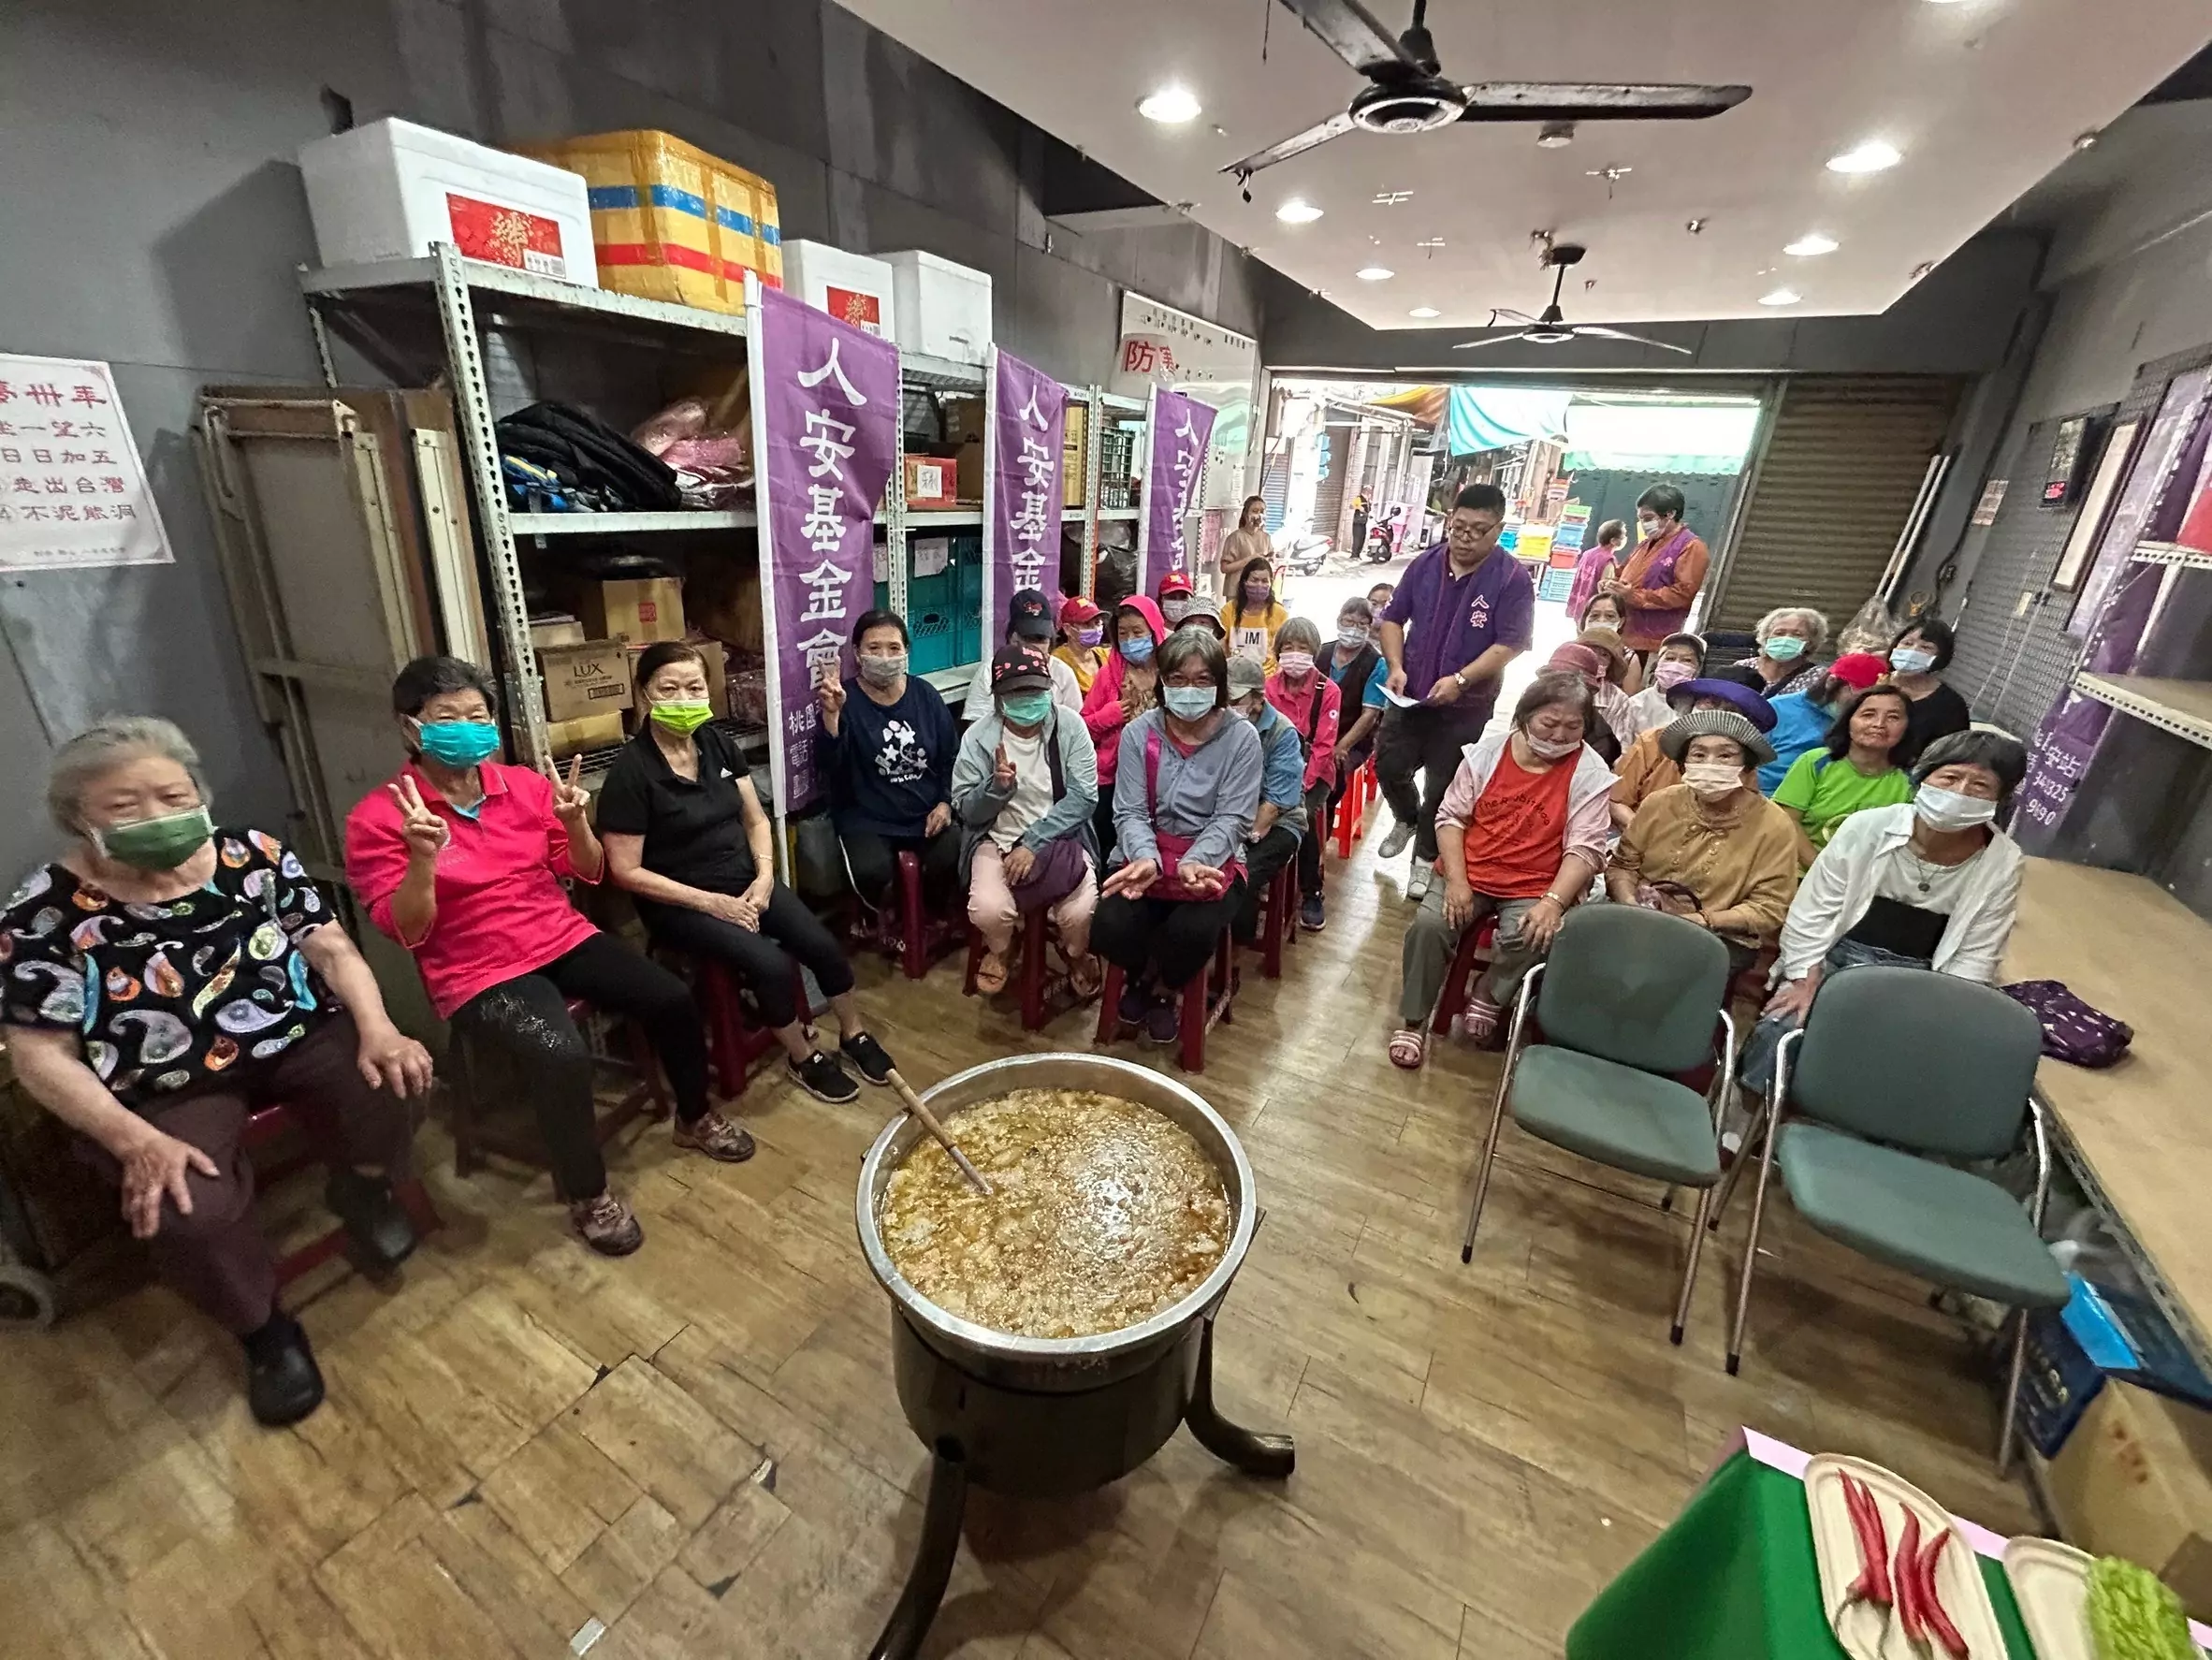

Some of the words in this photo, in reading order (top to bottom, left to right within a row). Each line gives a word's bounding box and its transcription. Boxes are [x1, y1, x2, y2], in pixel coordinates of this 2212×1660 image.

[797, 338, 867, 690] 人安基金會
[1010, 385, 1055, 591] 人安基金
[574, 663, 604, 677] LUX
